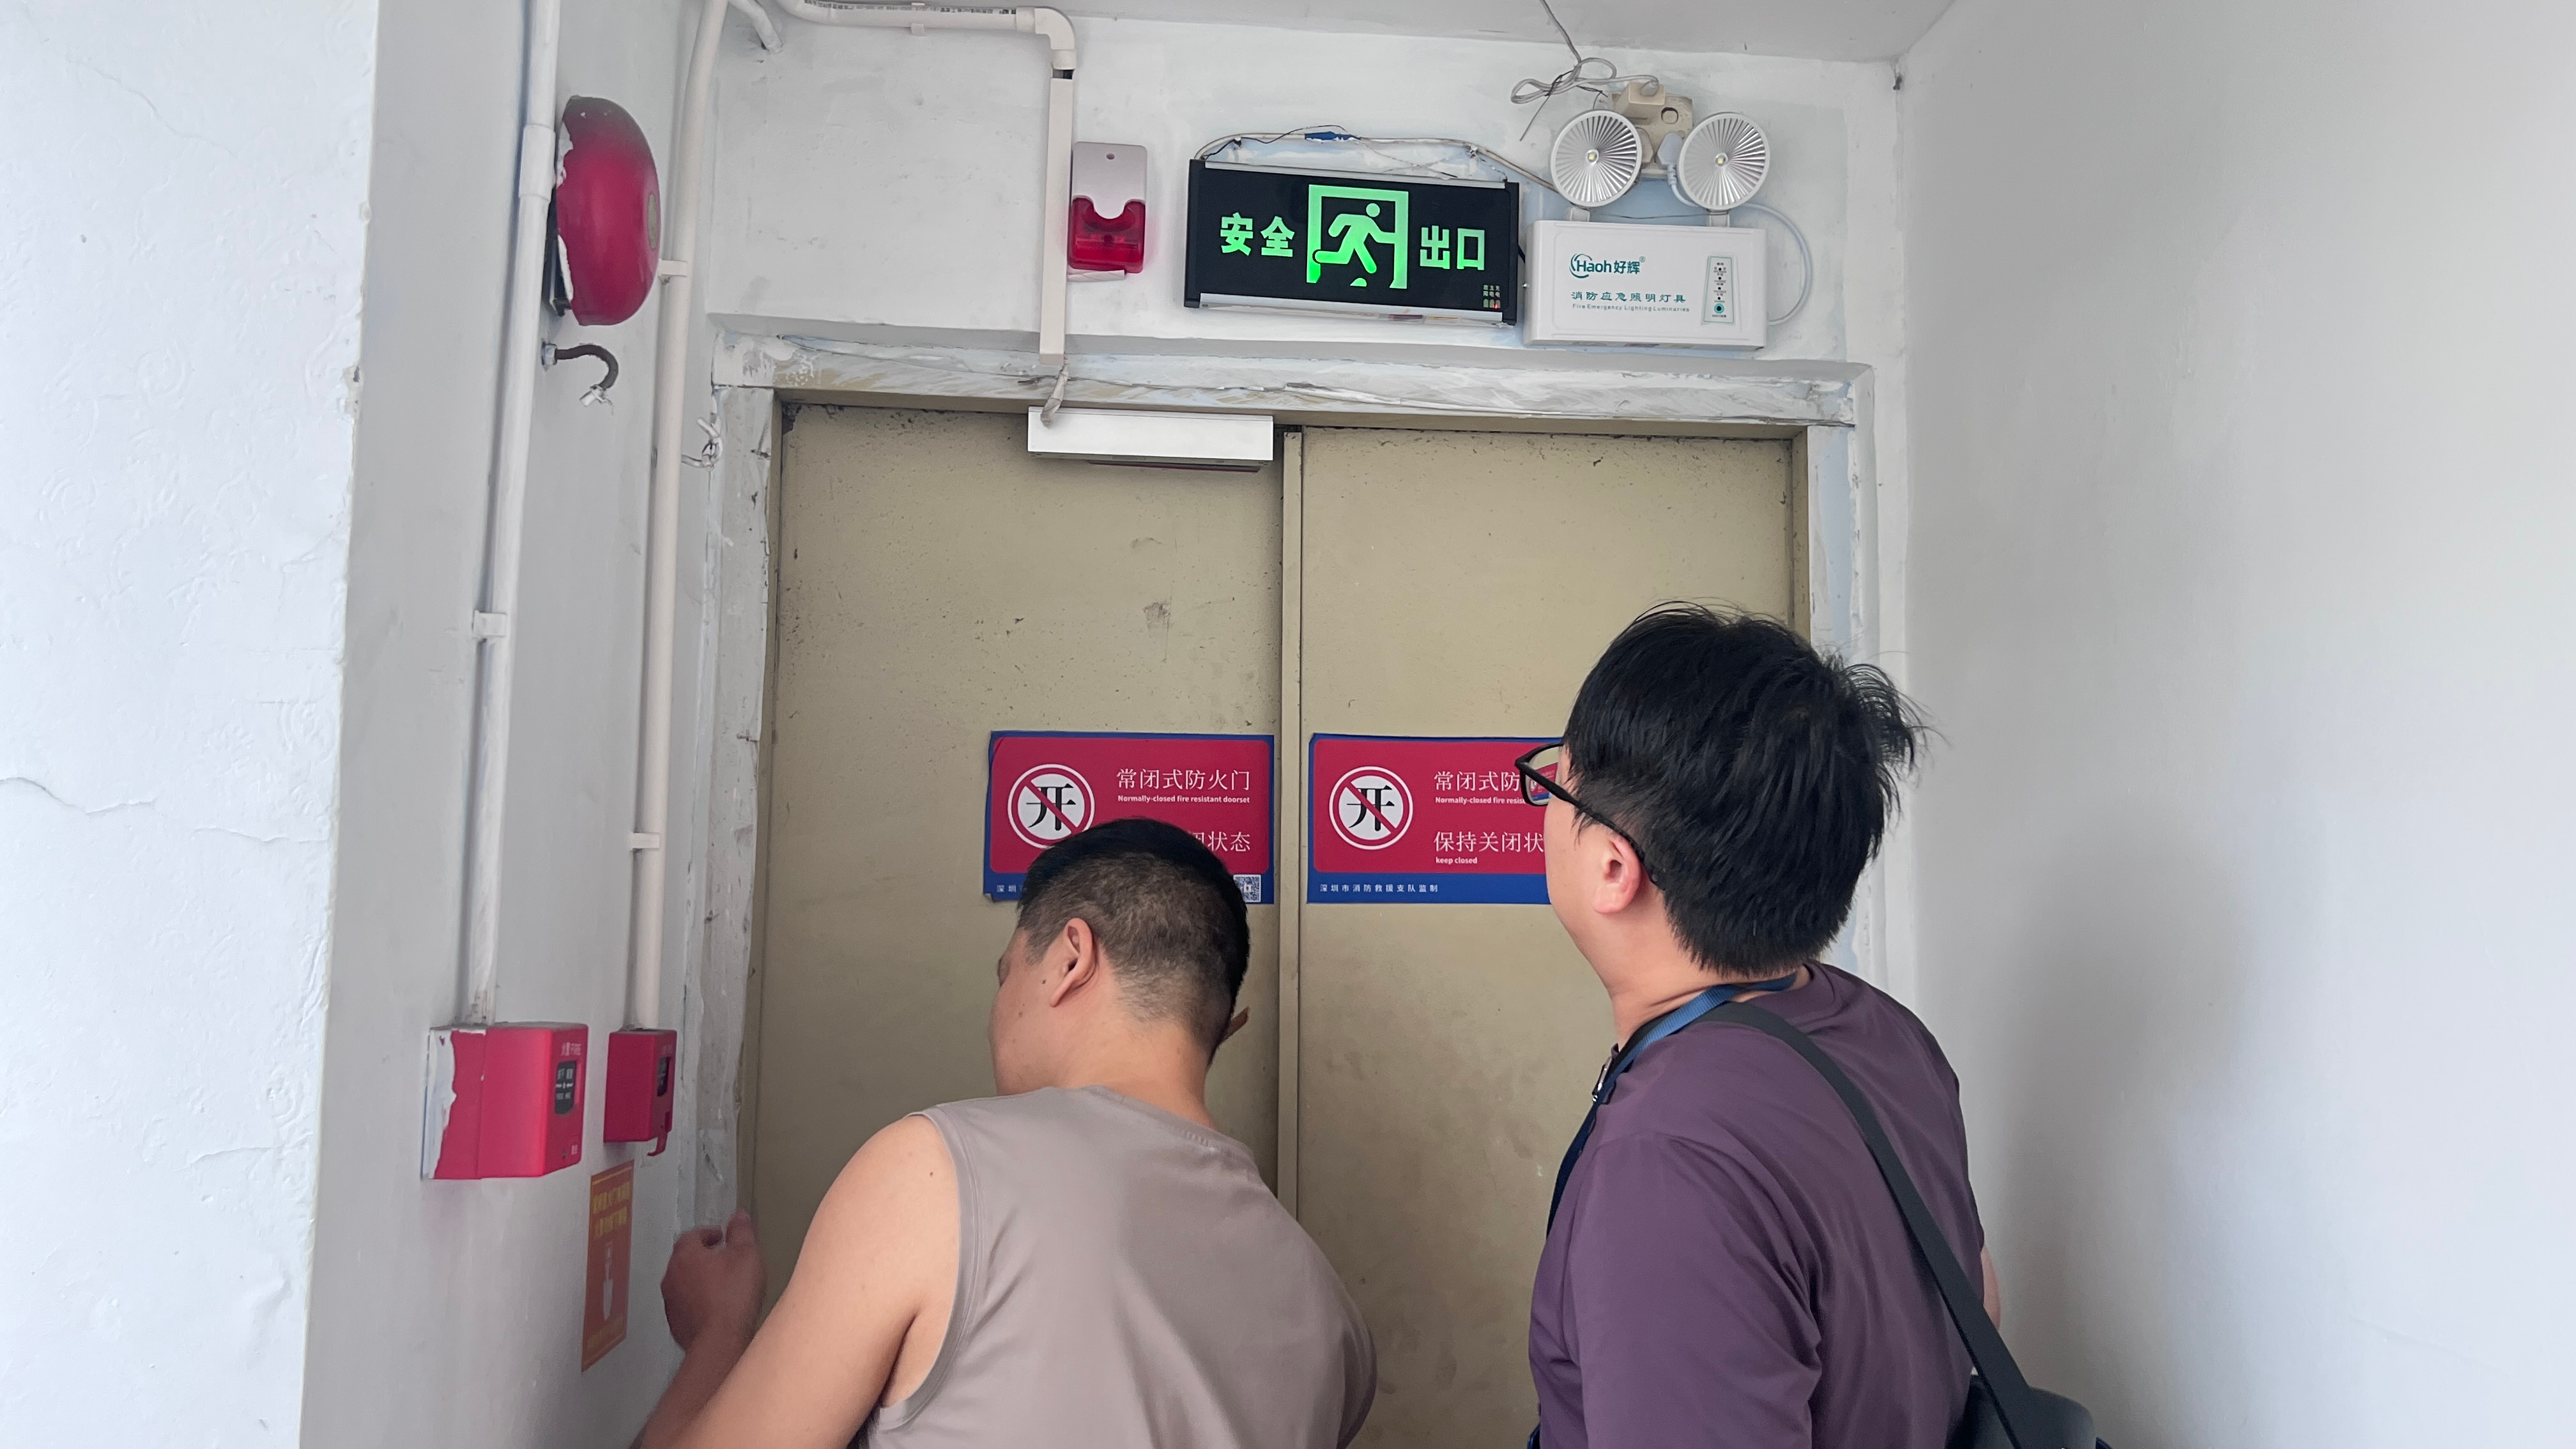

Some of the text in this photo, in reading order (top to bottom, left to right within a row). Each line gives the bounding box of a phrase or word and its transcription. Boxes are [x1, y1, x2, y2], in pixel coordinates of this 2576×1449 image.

[1220, 211, 1485, 271] 安全 出口
[1576, 259, 1640, 275] Haoh 好辉
[1570, 291, 1687, 303] 消防应急照明灯具
[1116, 769, 1250, 791] 常闭式防火门
[1117, 795, 1176, 804] Normally-closed
[1177, 795, 1190, 803] fire
[1223, 795, 1250, 804] doorset
[1435, 796, 1492, 805] Normally-closed
[1434, 831, 1544, 853] 保持关闭状
[1436, 856, 1478, 865] keep closed
[1320, 884, 1439, 893] 深圳市消防救援支队监制
